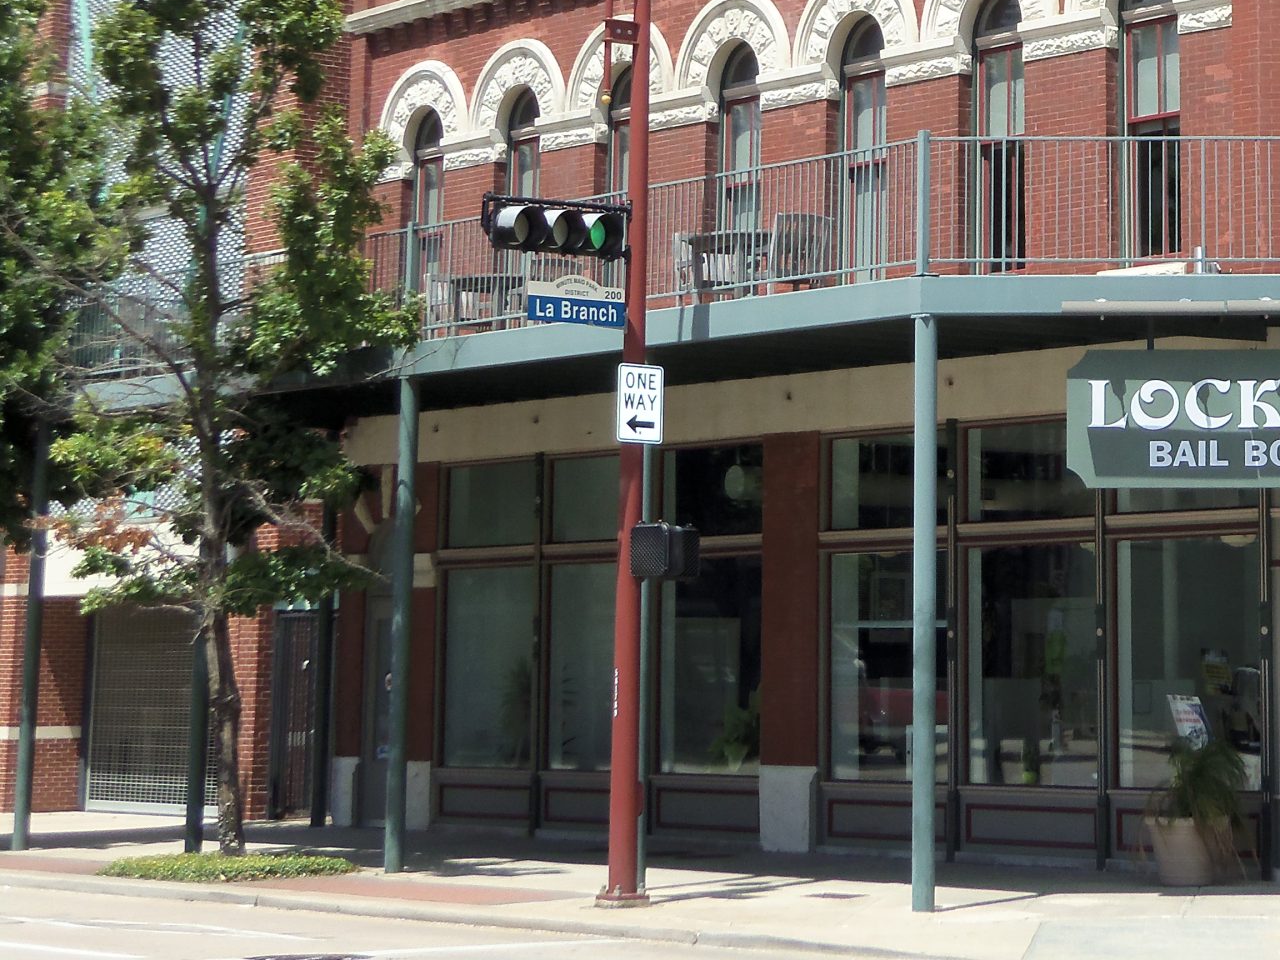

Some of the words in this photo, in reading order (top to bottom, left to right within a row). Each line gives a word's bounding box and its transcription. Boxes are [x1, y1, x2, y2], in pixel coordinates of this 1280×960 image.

[564, 289, 589, 297] DISTRICT
[585, 281, 598, 293] PARK
[604, 291, 622, 300] 200
[536, 299, 554, 317] La
[561, 300, 617, 322] Branch
[625, 371, 657, 391] ONE
[624, 392, 657, 411] WAY
[1149, 440, 1229, 467] BAIL
